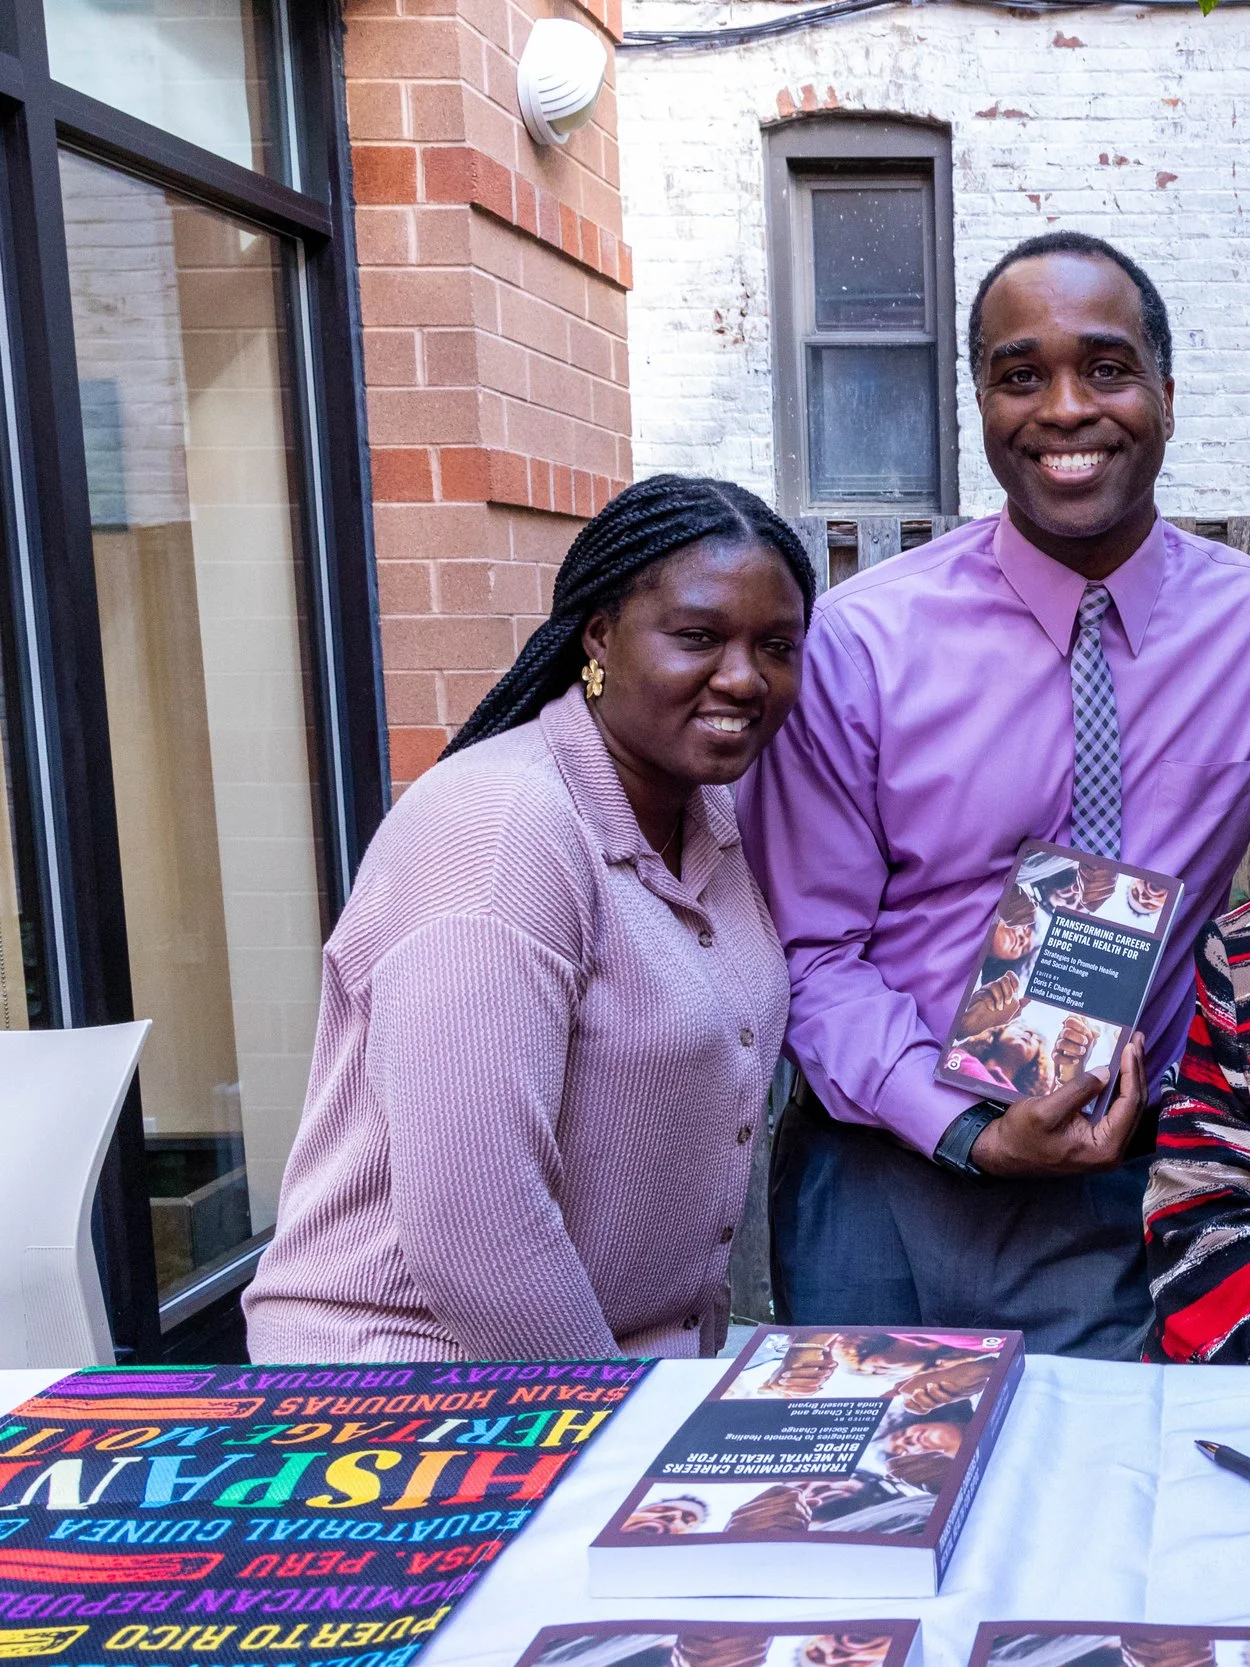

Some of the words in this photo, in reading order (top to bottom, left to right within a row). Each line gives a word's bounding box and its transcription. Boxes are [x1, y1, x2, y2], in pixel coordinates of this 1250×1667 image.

[1055, 915, 1114, 942] TRANSFORMING
[1115, 933, 1151, 952] CAREERS
[1047, 937, 1073, 952] BIPOC
[1051, 927, 1062, 938] IN
[1062, 929, 1092, 947] MENTAL
[1092, 938, 1122, 955] HEALTH
[1122, 947, 1139, 961] FOR
[1040, 957, 1052, 968] and
[1052, 960, 1069, 973] Social
[1068, 965, 1089, 978] Change
[1043, 949, 1071, 966] Strategies
[1070, 957, 1077, 965] to
[1077, 958, 1099, 972] Promote
[1099, 964, 1119, 979] Healing
[1036, 970, 1051, 979] EDITED
[1033, 977, 1047, 988] Doris
[1054, 983, 1071, 997] Chang
[1072, 989, 1083, 998] and
[1030, 987, 1046, 998] Linda
[1046, 991, 1066, 1004] Lausell
[1066, 996, 1084, 1009] Bryant
[218, 1369, 414, 1391] URUGUAY
[273, 1389, 497, 1416] HONDURAS
[508, 1385, 630, 1404] SPAIN
[788, 1401, 818, 1409] Bryant
[811, 1408, 842, 1416] Chang
[222, 1409, 613, 1447] HERITAGE
[724, 1433, 762, 1441] Healing
[781, 1426, 817, 1434] Change
[816, 1433, 865, 1441] Strategies
[813, 1442, 860, 1452] BIPOC
[686, 1453, 717, 1462] FOR
[718, 1453, 775, 1463] HEALTH
[778, 1453, 832, 1463] MENTAL
[835, 1453, 854, 1462] IN
[662, 1463, 731, 1473] CAREERS
[735, 1463, 848, 1473] TRANSFORMING
[48, 1519, 234, 1543] GUINEA
[246, 1509, 532, 1543] EQUATORIAL
[236, 1551, 376, 1578] PERU
[184, 1572, 479, 1614] DOMINICAN
[104, 1624, 238, 1651] RICO
[239, 1606, 451, 1650] PUERTO
